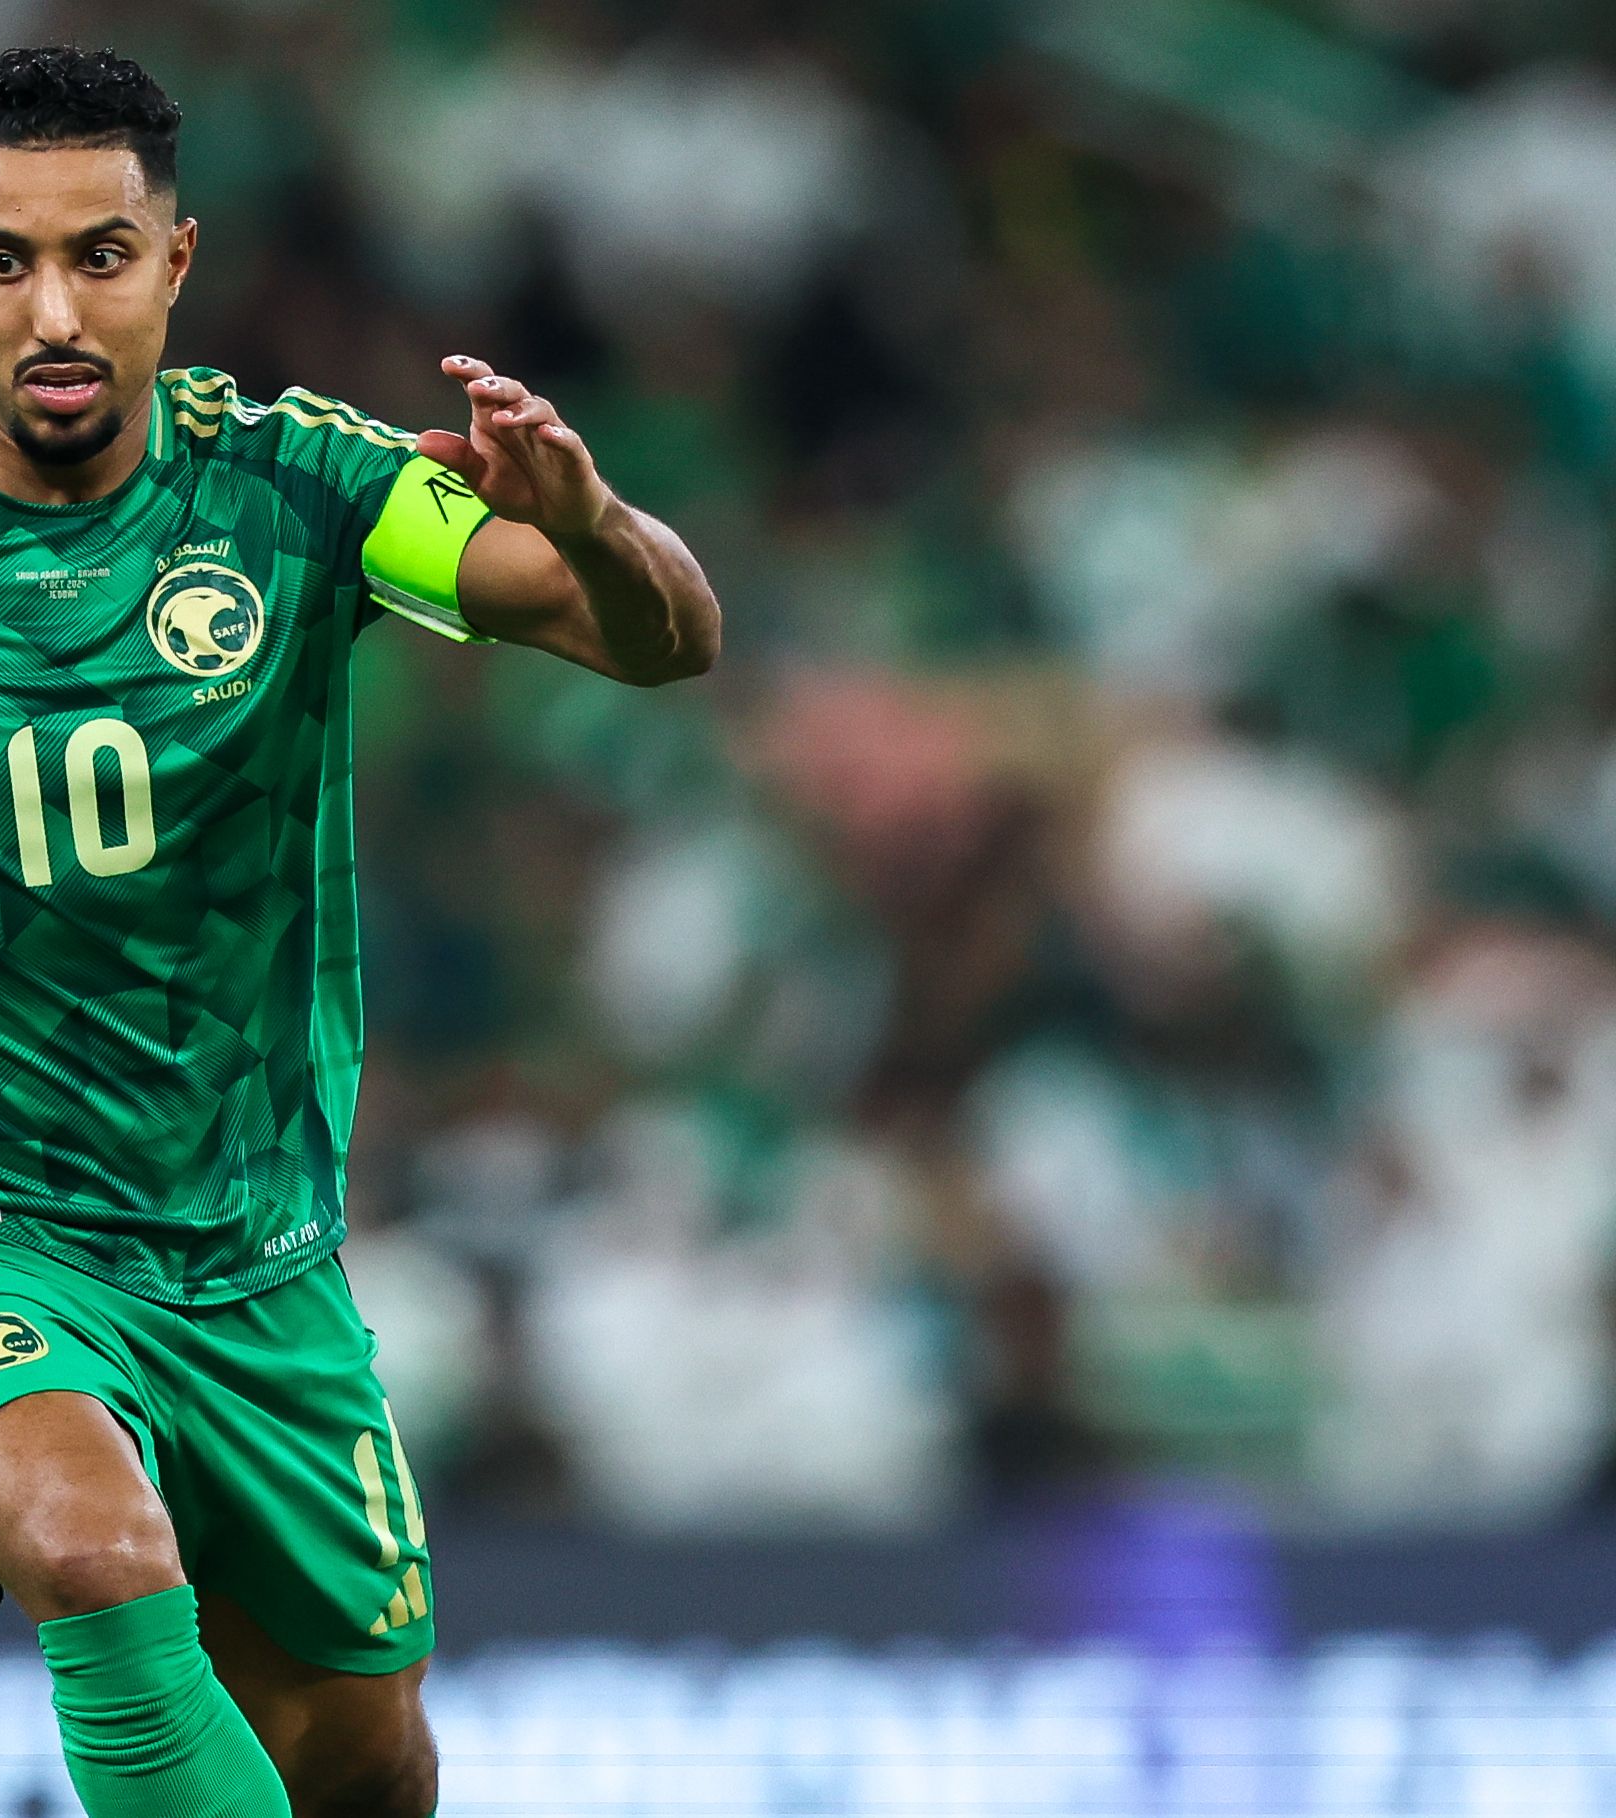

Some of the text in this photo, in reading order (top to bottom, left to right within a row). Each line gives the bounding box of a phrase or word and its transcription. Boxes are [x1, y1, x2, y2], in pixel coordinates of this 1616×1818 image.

[49, 580, 65, 589] OCT
[66, 580, 87, 589] 2024
[49, 590, 78, 599] JEDDAH
[213, 622, 246, 640] SAFF
[192, 677, 252, 706] SAUDI
[7, 718, 157, 887] 10
